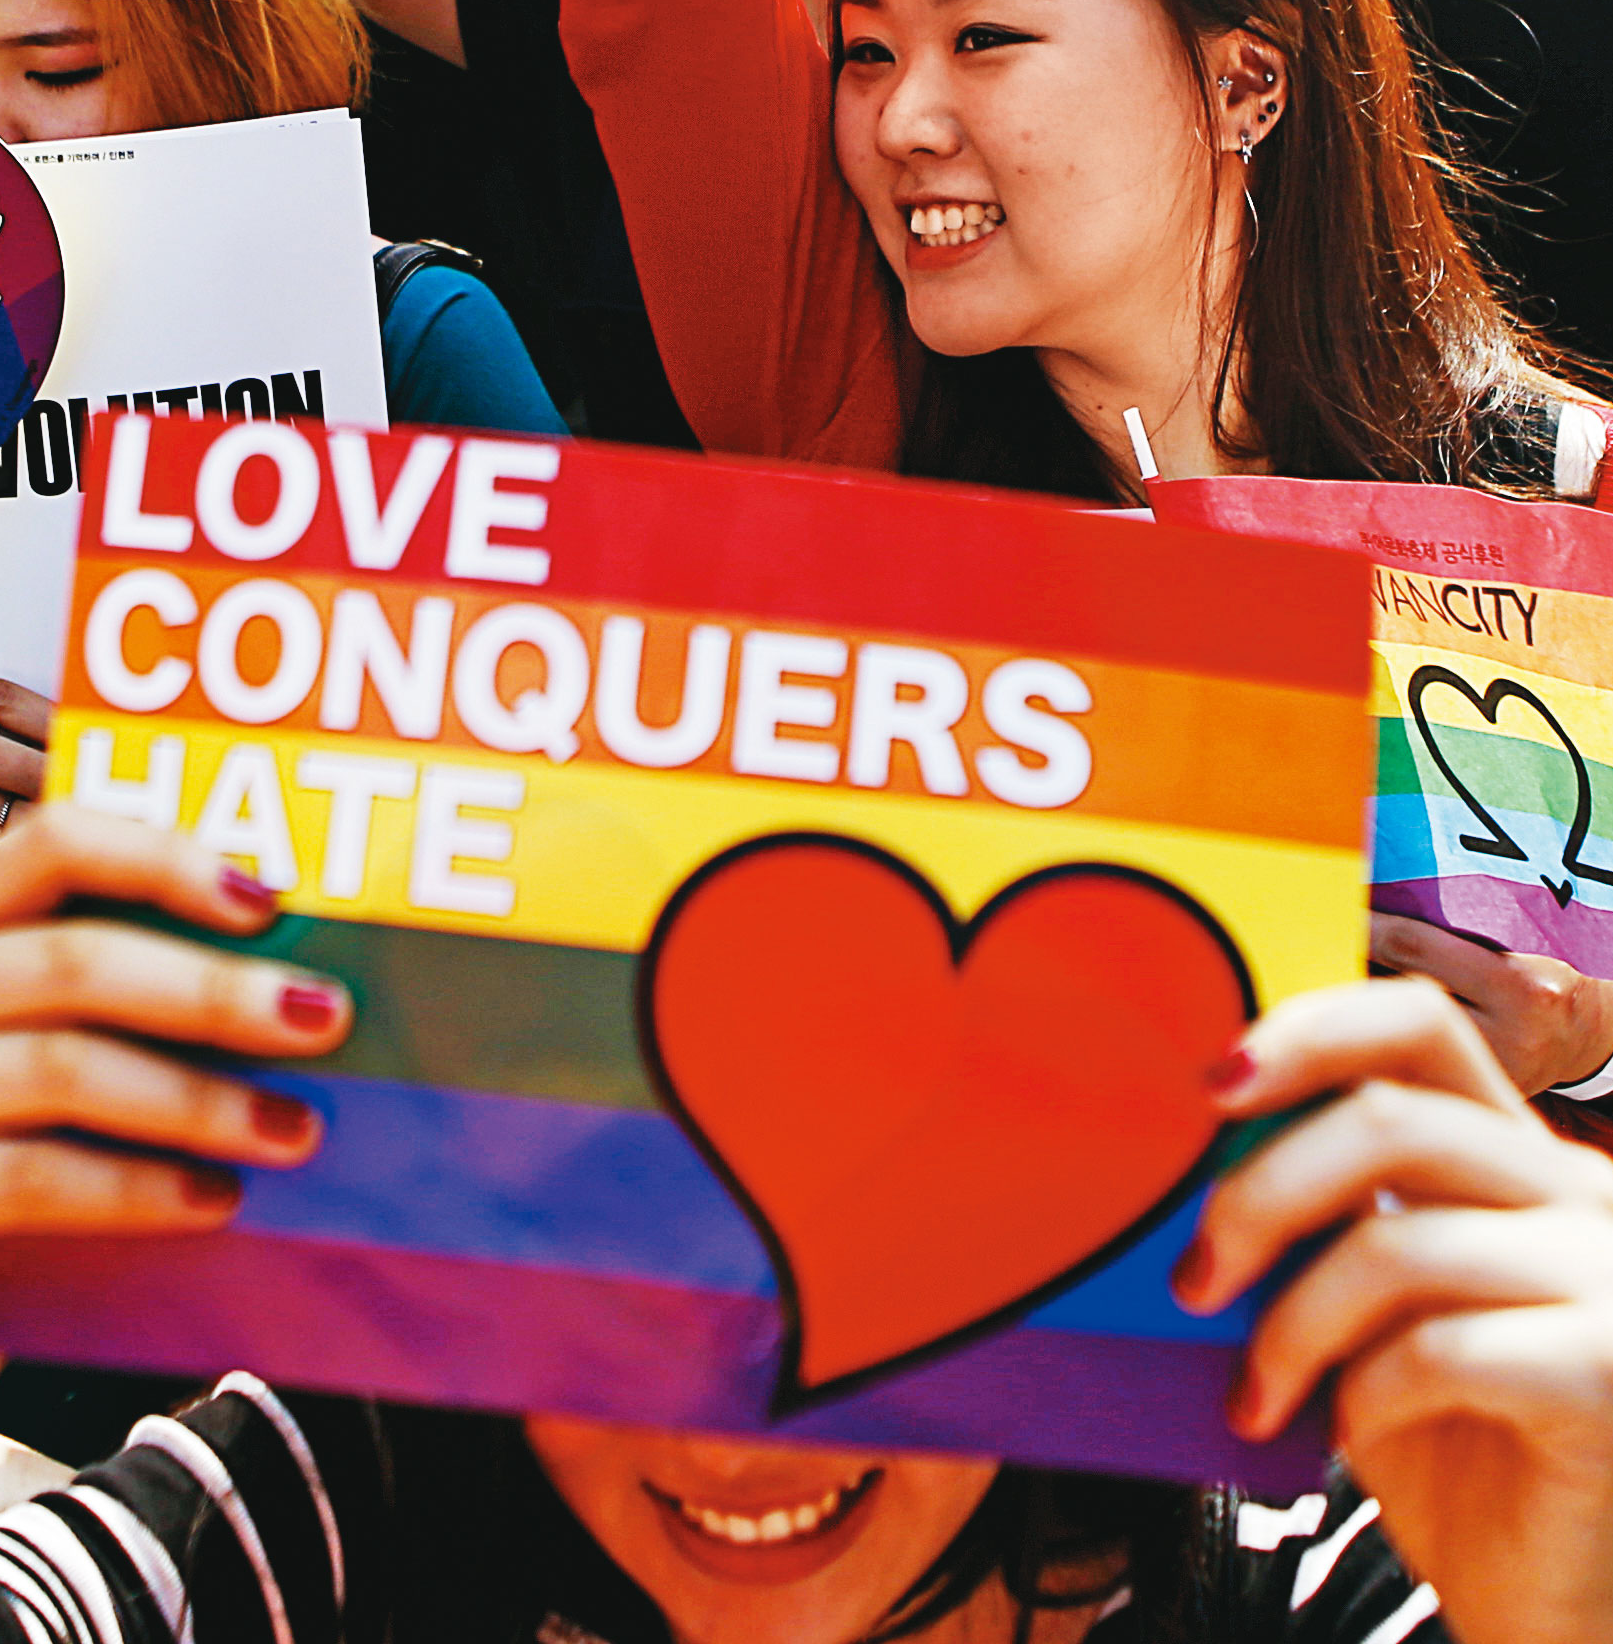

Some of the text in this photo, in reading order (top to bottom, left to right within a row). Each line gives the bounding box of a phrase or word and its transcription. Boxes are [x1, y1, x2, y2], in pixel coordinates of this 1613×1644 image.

[99, 414, 563, 586] LOVE
[81, 566, 1096, 812] CONQUERS
[72, 724, 528, 918] HATE
